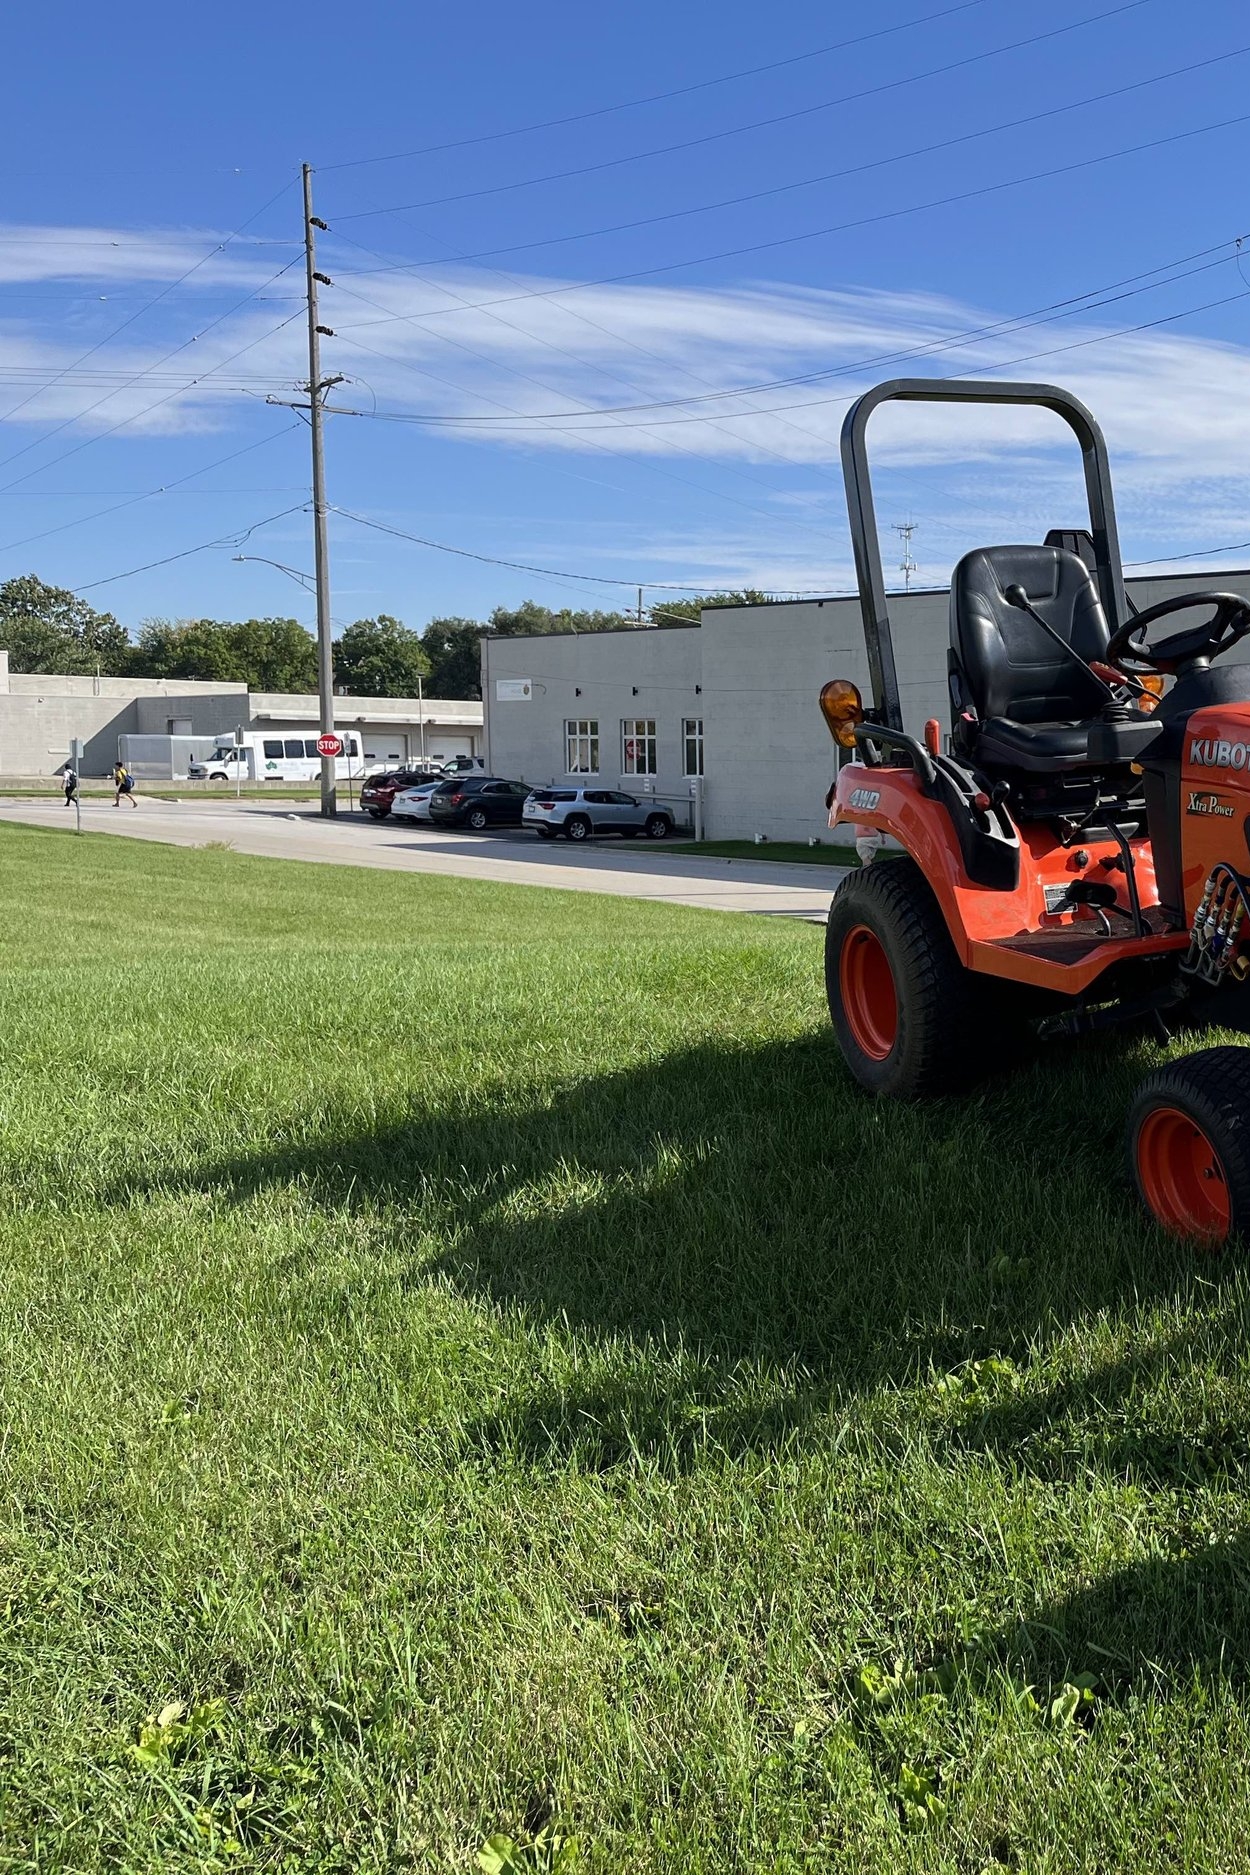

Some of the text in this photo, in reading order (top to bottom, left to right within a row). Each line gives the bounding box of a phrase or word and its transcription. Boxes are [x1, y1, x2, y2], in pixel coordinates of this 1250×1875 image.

[318, 740, 340, 750] STOP
[849, 789, 880, 810] 4WD
[1187, 792, 1234, 817] Xtra Power
